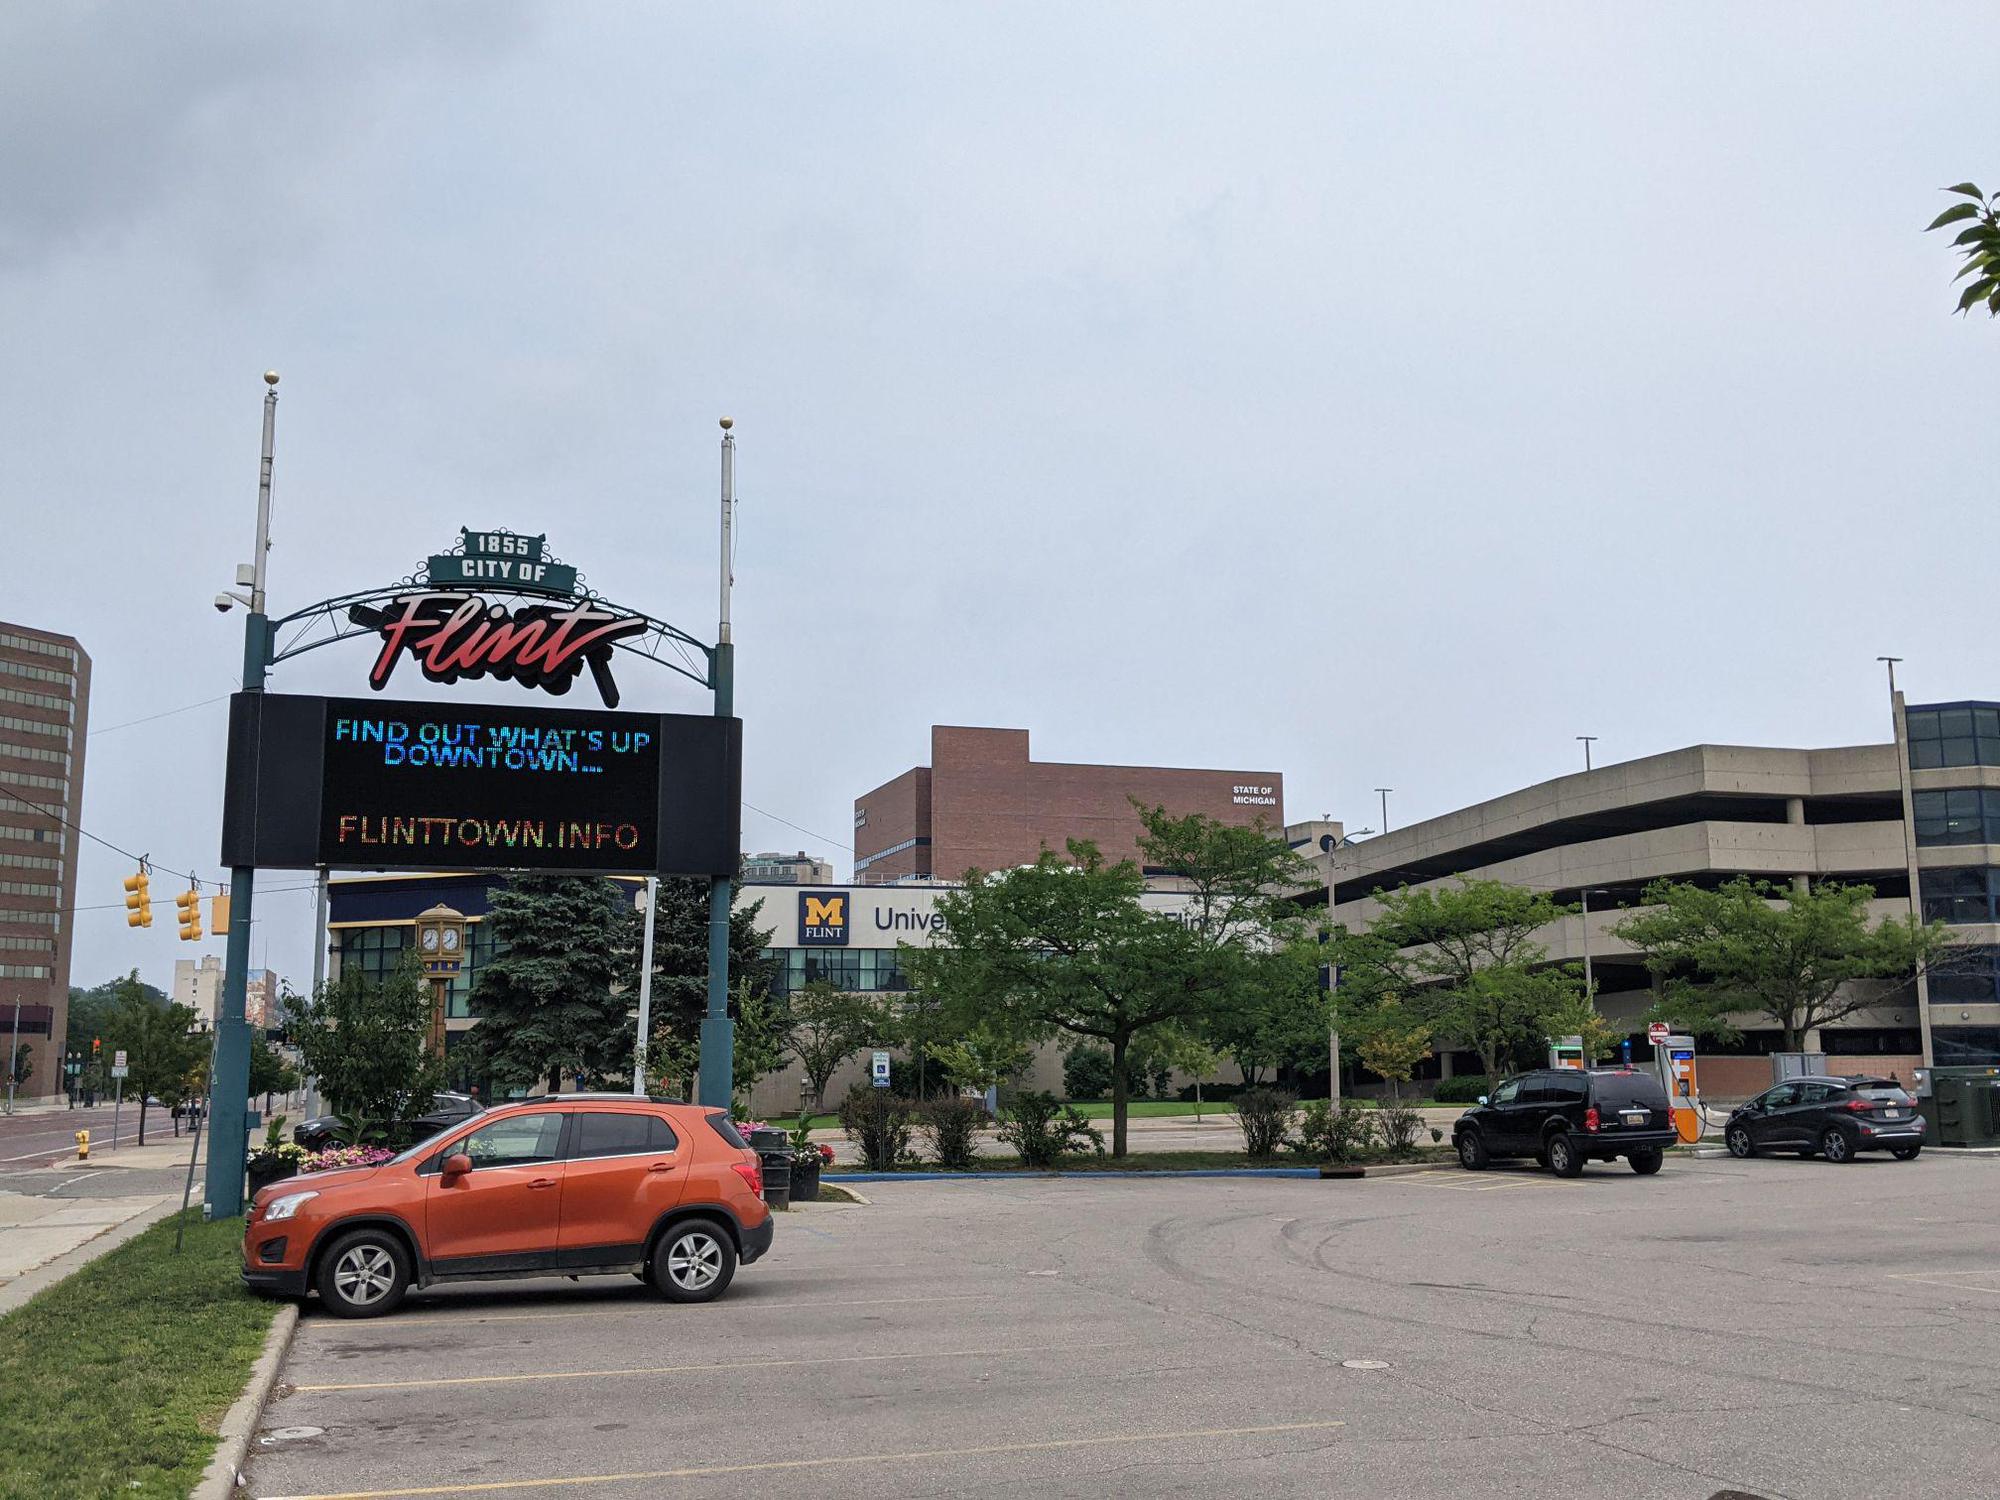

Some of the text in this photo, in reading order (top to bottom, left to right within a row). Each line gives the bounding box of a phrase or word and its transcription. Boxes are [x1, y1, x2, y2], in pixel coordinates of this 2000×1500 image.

[478, 535, 529, 556] 1855
[461, 559, 546, 582] CITY OF
[373, 592, 646, 681] Flint
[336, 718, 650, 753] FIND OUT WHAT'S UP
[1233, 785, 1273, 795] STATE OF
[1233, 796, 1276, 806] MICHIGAN
[339, 815, 638, 849] FLINTTOWN.INFO
[805, 897, 843, 926] M
[805, 927, 843, 938] FLINT
